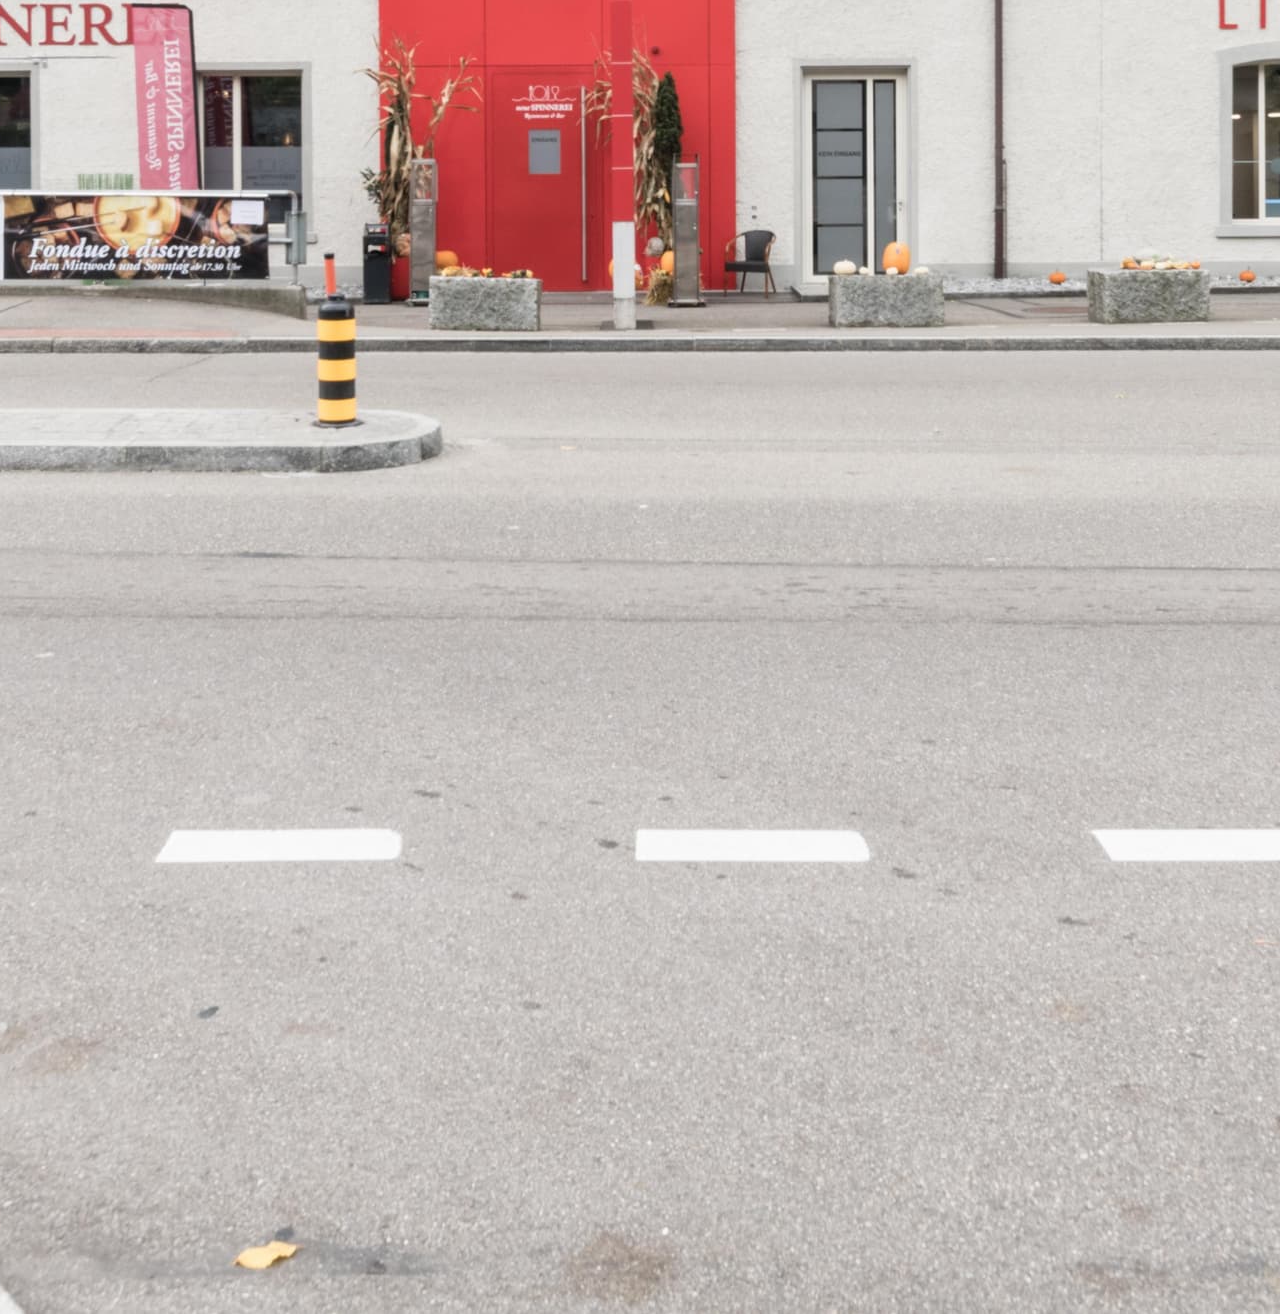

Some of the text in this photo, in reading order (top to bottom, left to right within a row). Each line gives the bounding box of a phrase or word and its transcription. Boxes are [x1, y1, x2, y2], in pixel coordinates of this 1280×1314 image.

[28, 237, 241, 258] Fondue à discretion
[26, 259, 60, 273] Jeden
[61, 259, 115, 274] Mittwoch
[118, 259, 141, 271] und
[144, 259, 190, 273] Sonntag
[202, 263, 224, 271] 17.30
